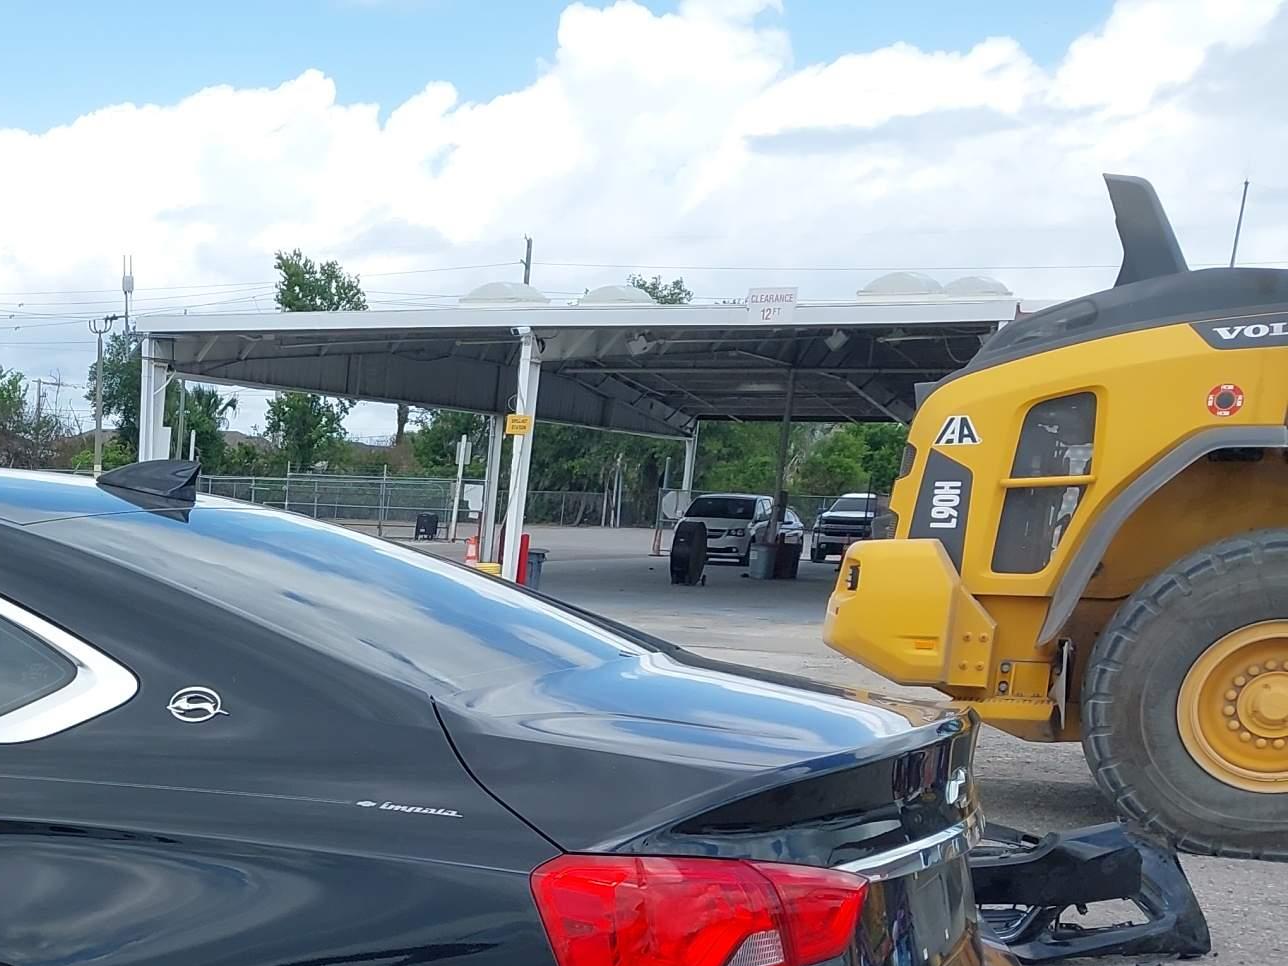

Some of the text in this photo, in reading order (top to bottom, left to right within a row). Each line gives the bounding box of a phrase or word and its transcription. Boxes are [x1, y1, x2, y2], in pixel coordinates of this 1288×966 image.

[751, 294, 793, 303] CLEARANCE
[761, 308, 772, 320] 12
[929, 481, 962, 528] L90H
